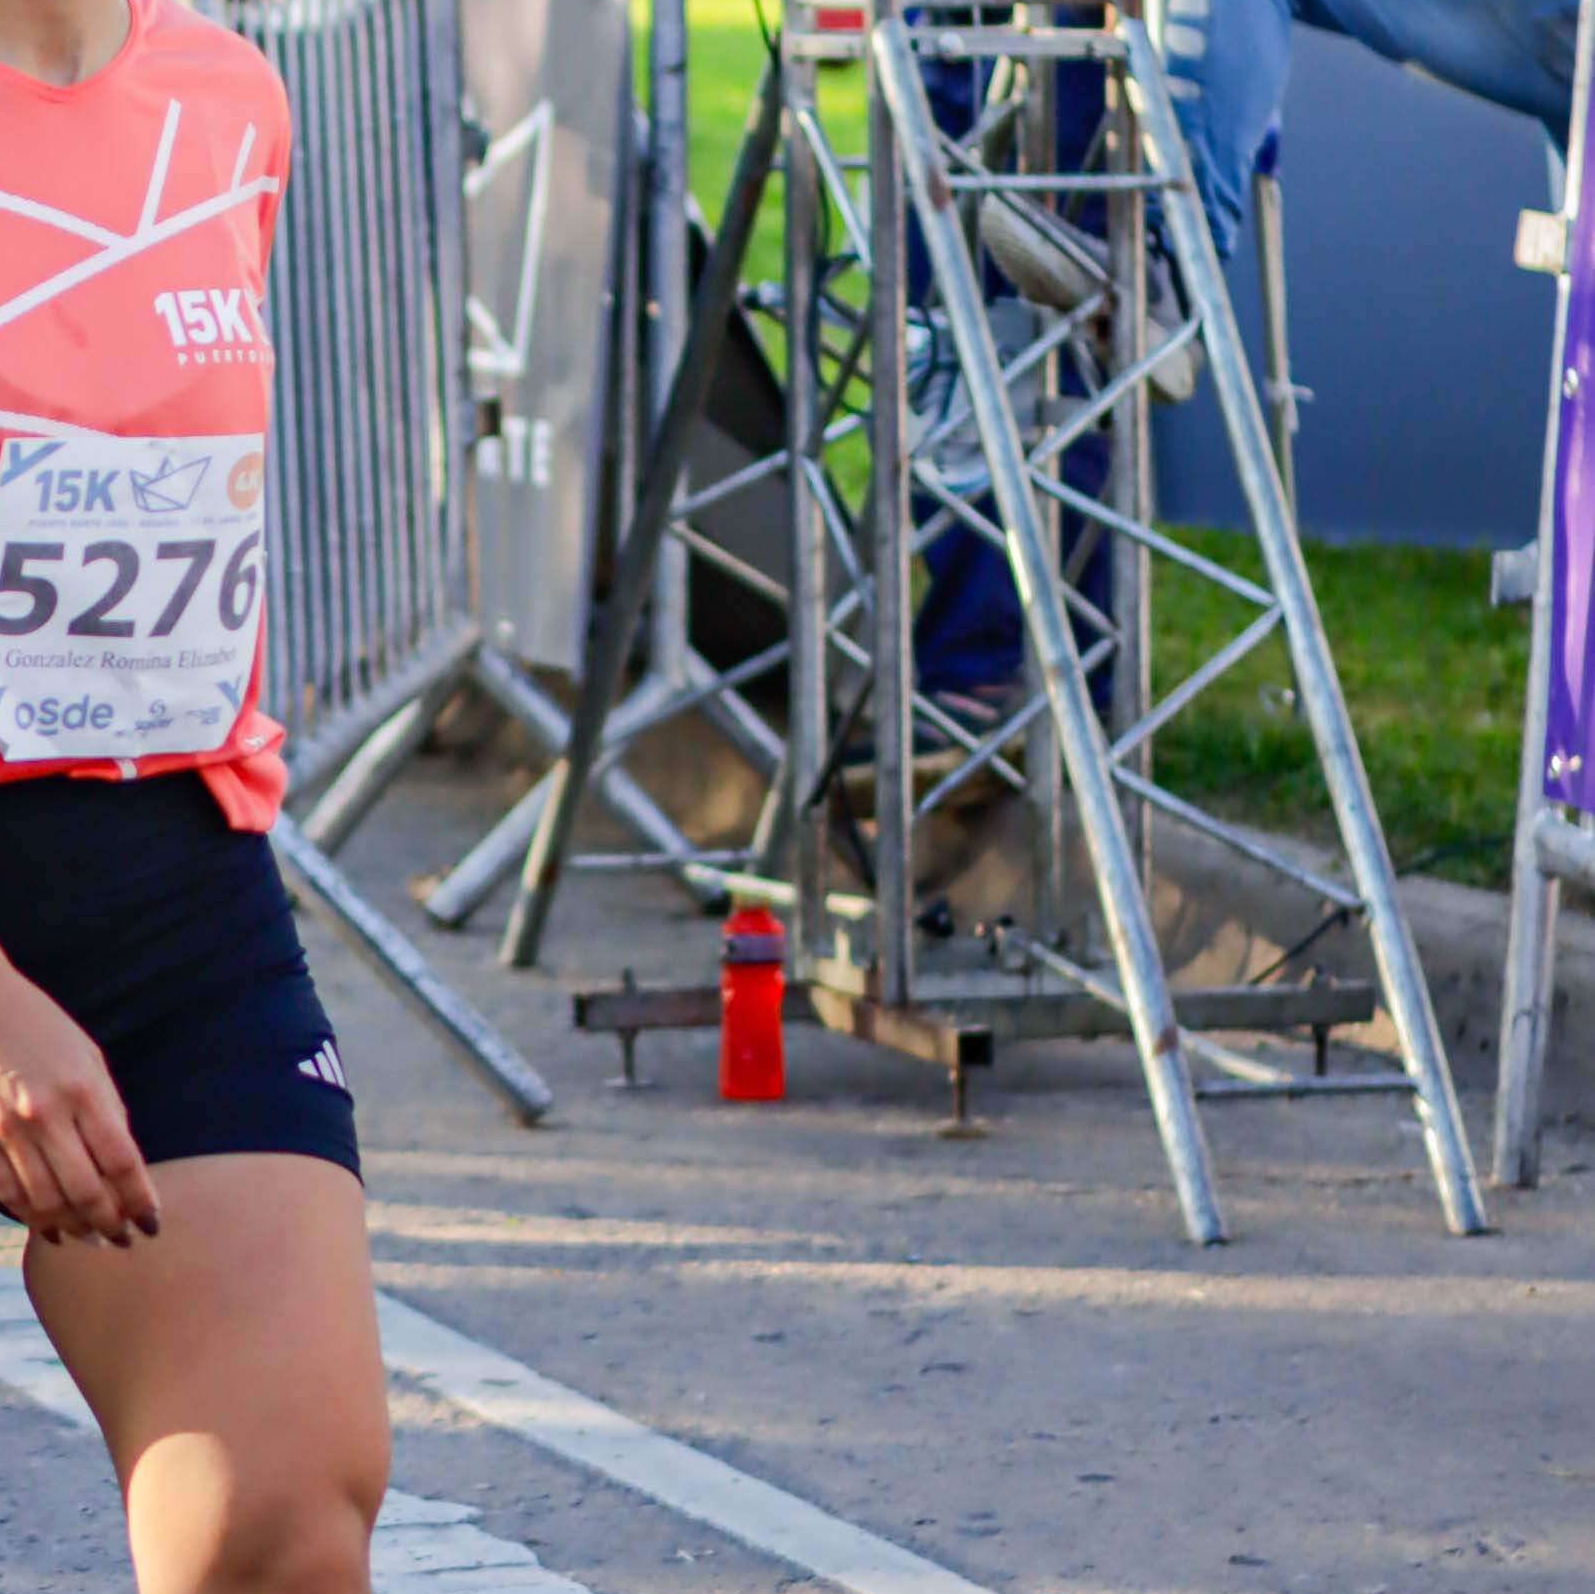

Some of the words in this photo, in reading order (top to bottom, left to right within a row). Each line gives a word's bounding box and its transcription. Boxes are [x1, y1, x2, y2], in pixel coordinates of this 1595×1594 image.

[154, 288, 253, 347] 15K
[35, 469, 121, 513] 15K
[5, 648, 96, 669] Gonzalez
[100, 653, 172, 670] Romina
[15, 693, 115, 737] osde
